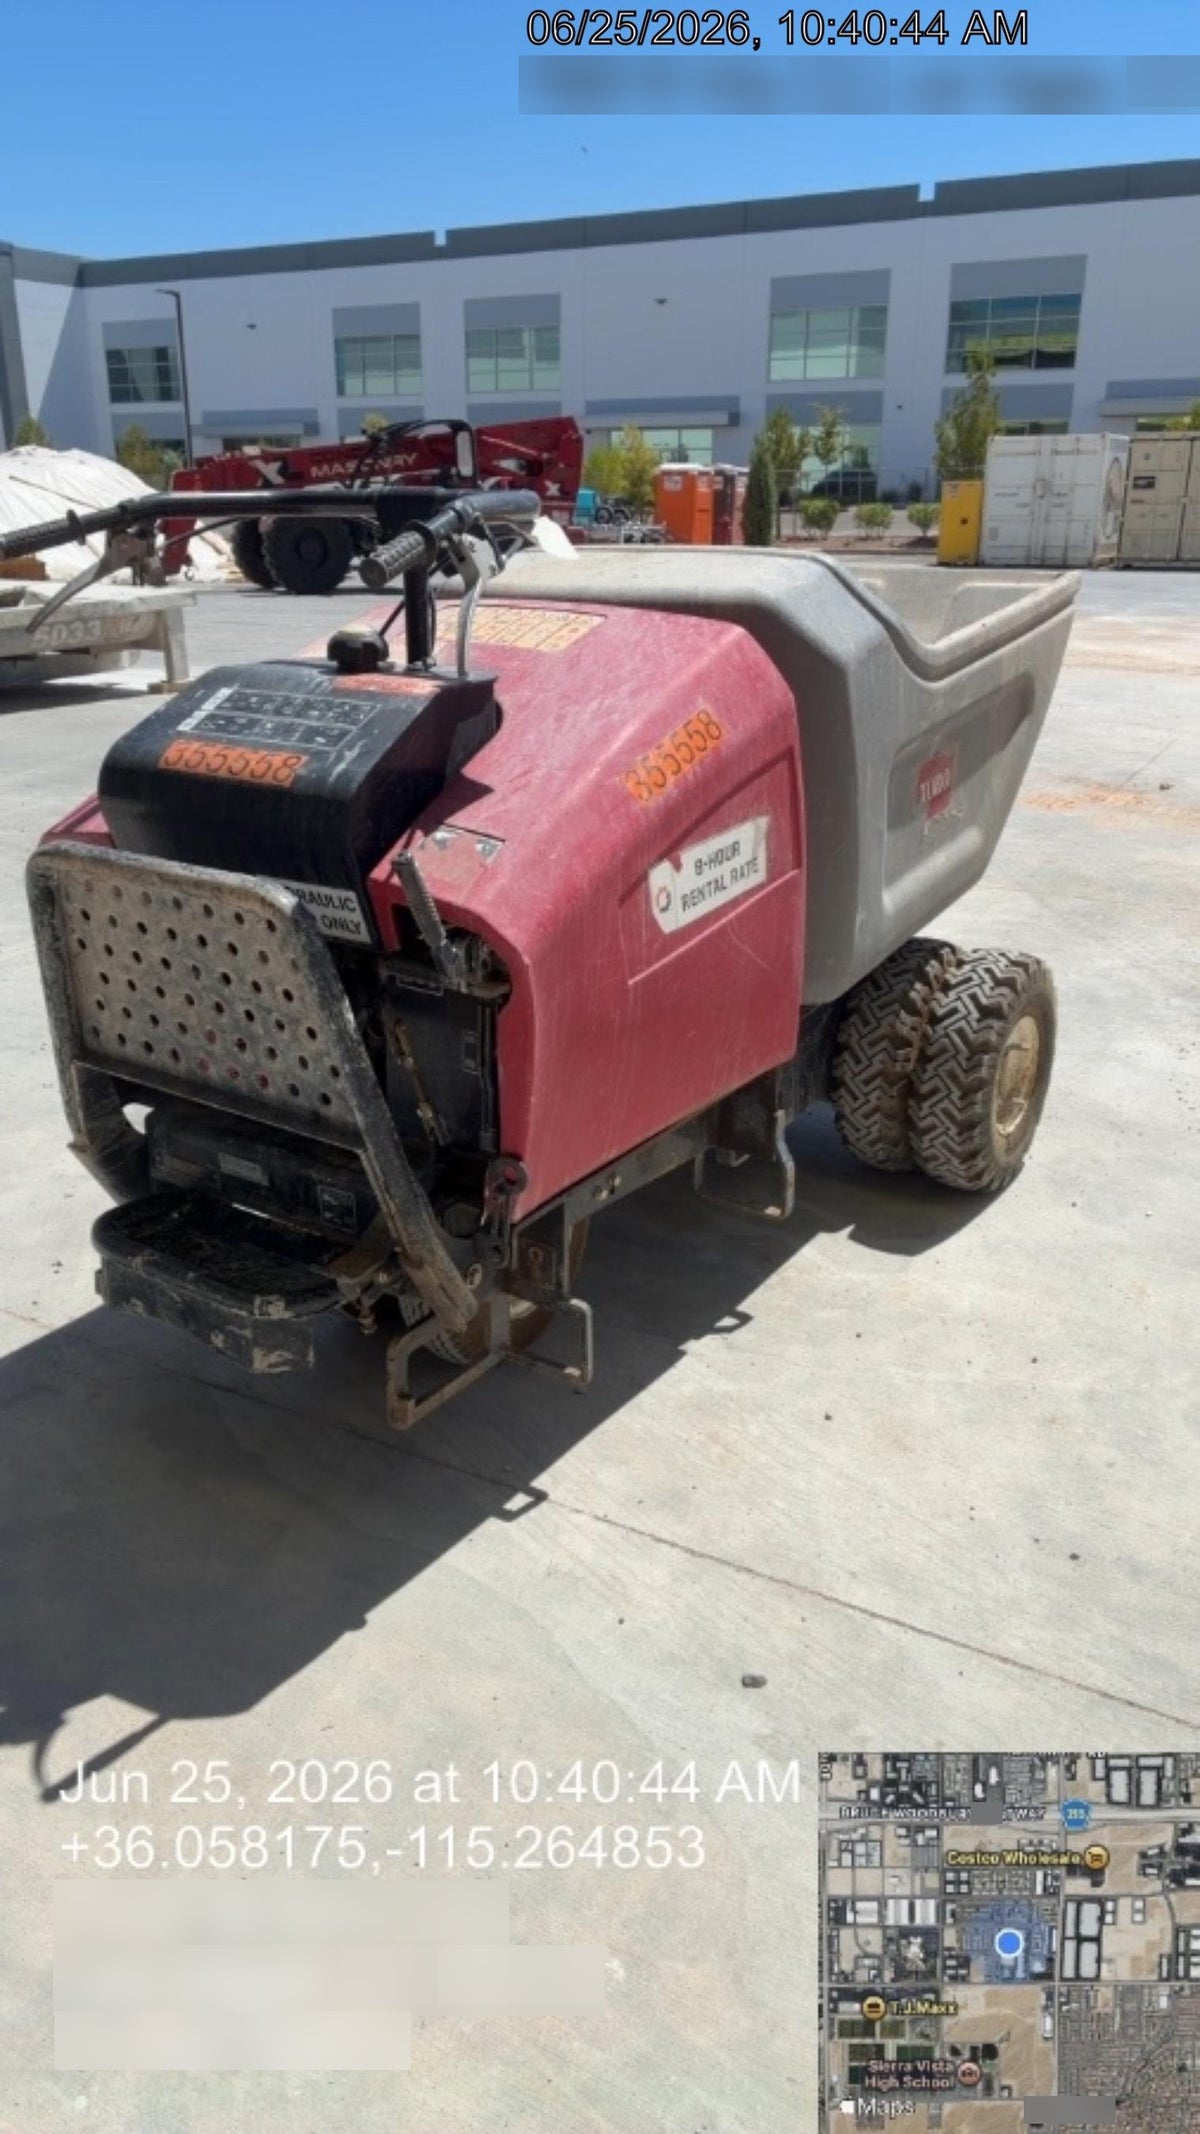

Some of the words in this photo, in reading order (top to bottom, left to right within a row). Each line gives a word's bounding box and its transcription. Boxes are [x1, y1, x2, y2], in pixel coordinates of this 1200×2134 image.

[694, 840, 741, 876] 8-HOUR
[680, 874, 727, 912] RENTAL
[729, 856, 760, 885] RATE
